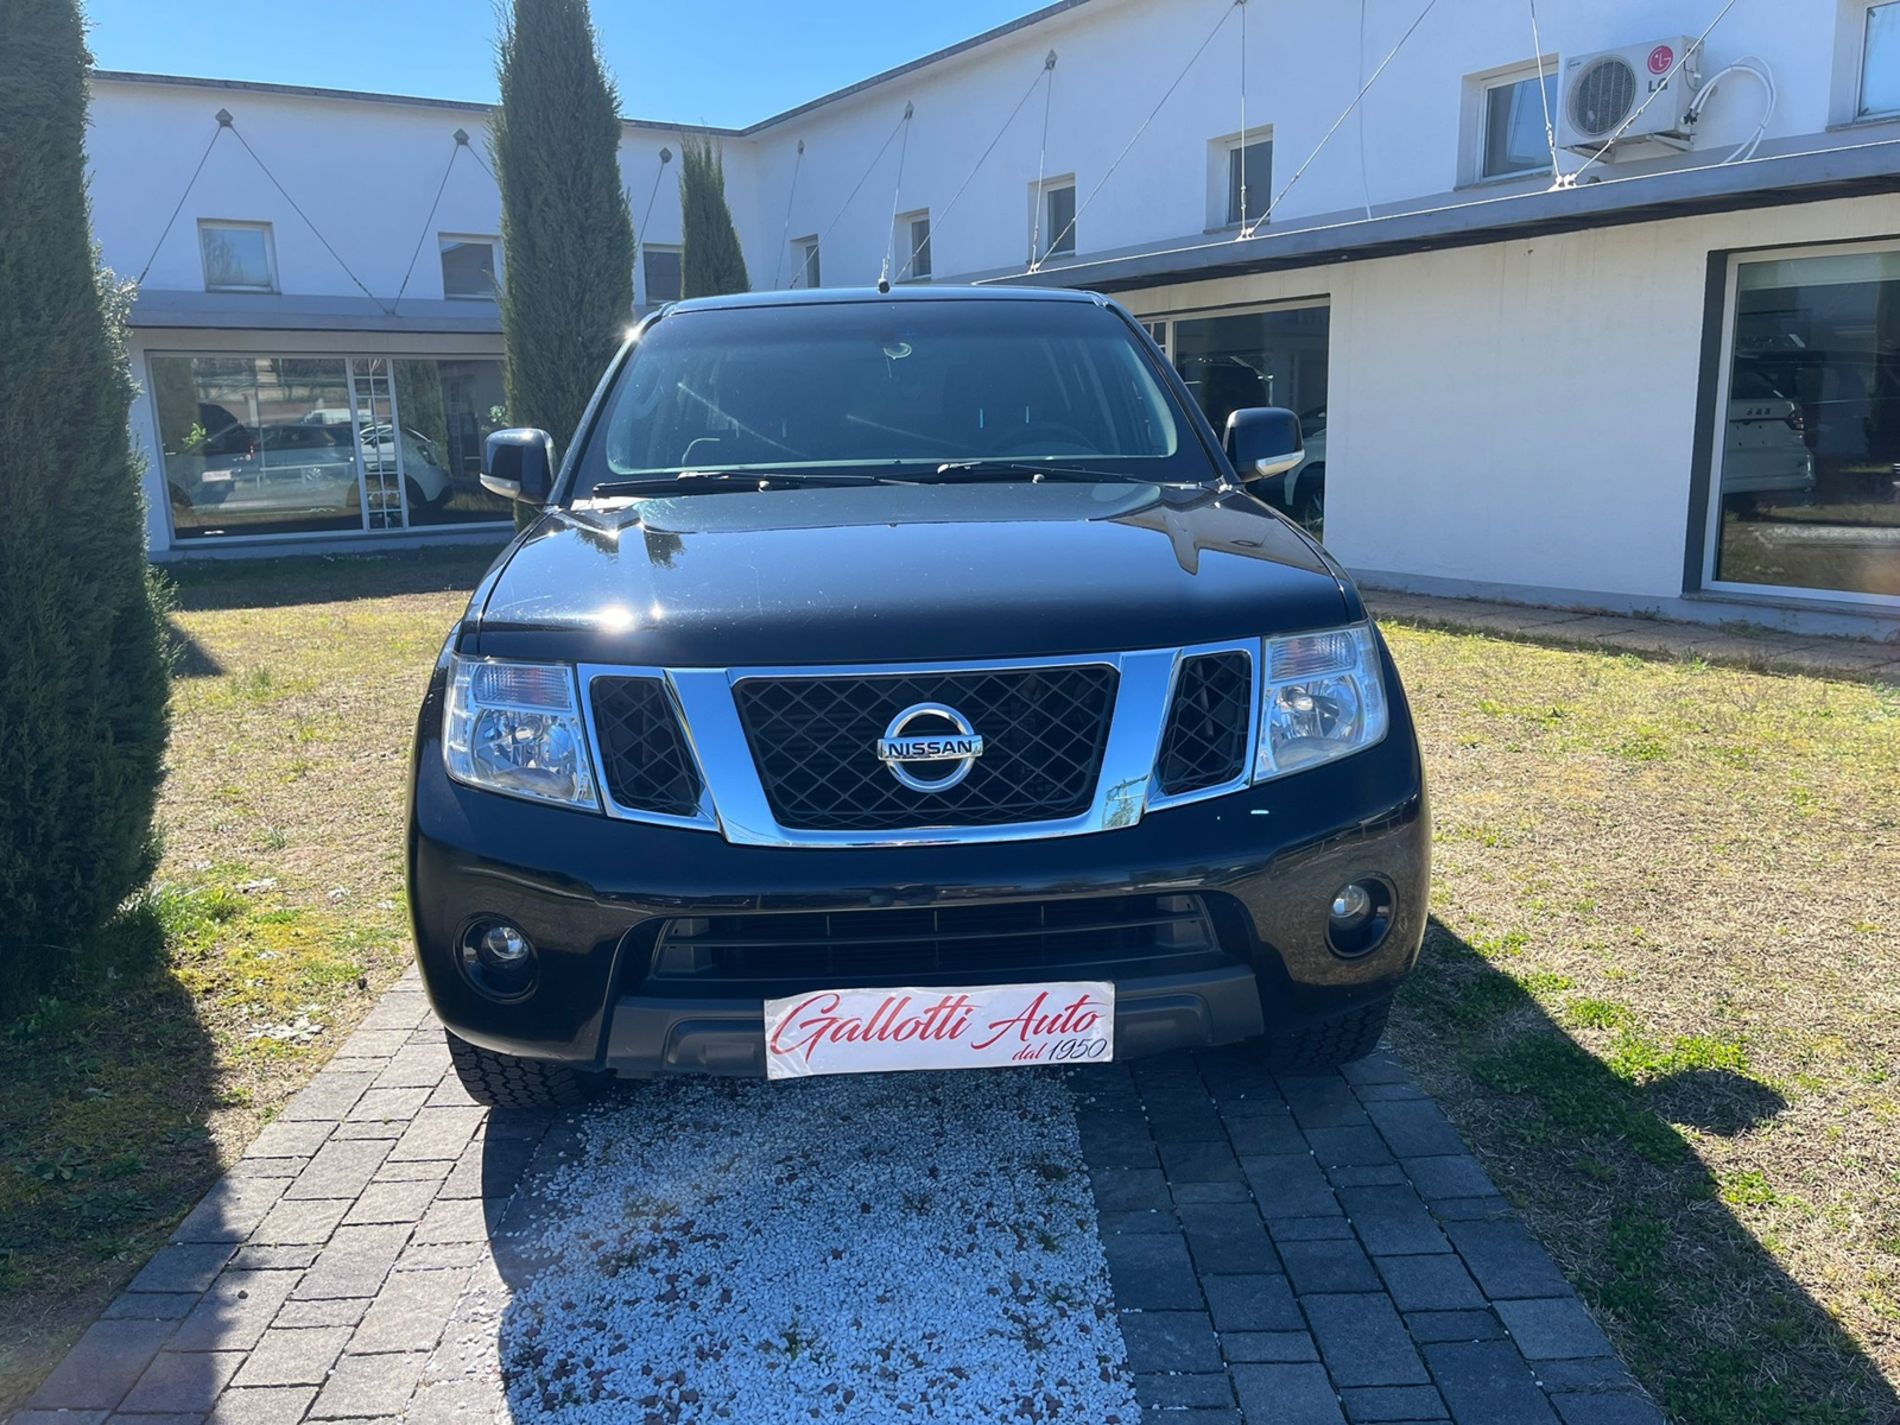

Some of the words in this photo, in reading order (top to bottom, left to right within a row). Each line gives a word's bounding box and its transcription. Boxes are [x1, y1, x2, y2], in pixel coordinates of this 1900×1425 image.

[1648, 77, 1668, 93] LG
[888, 740, 972, 756] NISSAN
[770, 993, 982, 1063] Gallotti
[971, 991, 1111, 1050] Auto
[1012, 1043, 1048, 1060] dal
[1048, 1038, 1108, 1061] 1950
